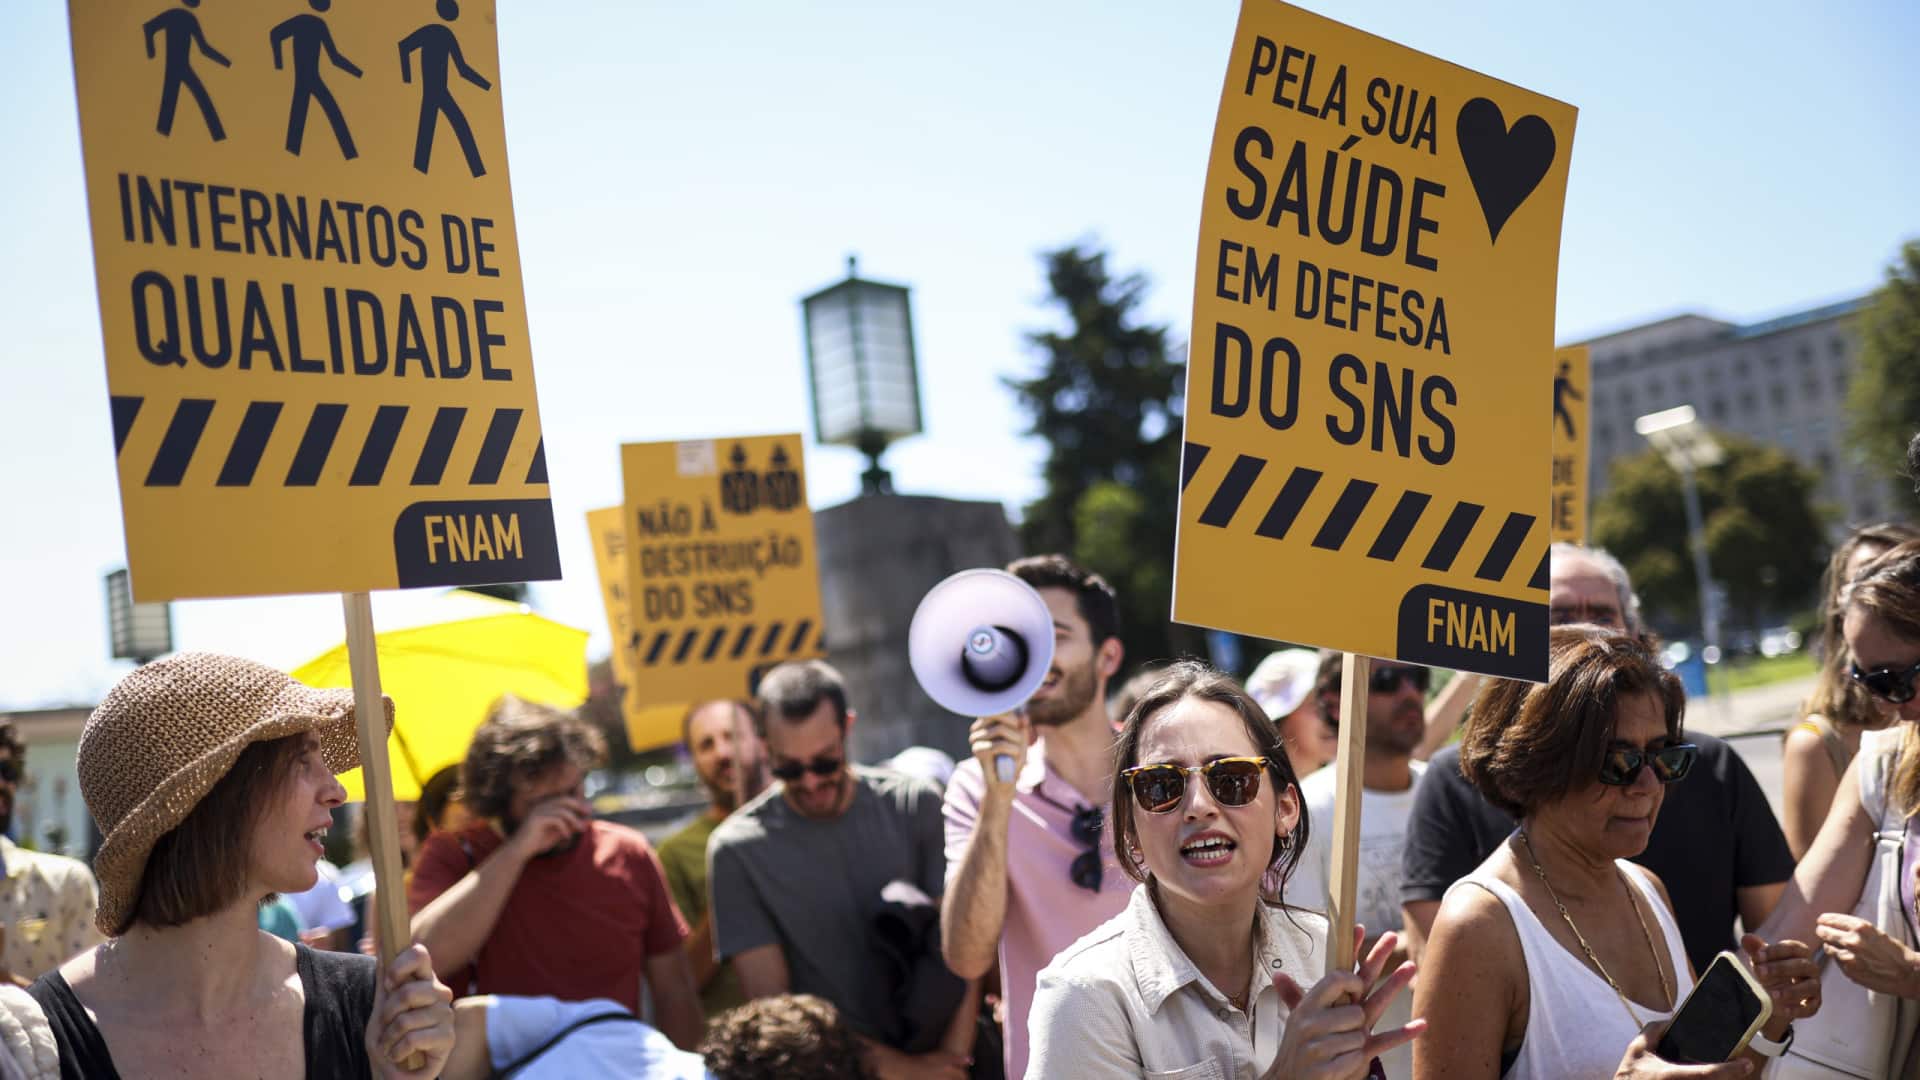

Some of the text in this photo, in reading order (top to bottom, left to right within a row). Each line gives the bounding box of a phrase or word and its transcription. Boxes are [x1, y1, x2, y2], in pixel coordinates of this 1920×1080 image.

[1245, 35, 1437, 155] PELA SUA
[117, 172, 500, 277] INTERNATOS DE
[1226, 126, 1447, 272] SAÚDE
[130, 270, 513, 382] QUALIDADE
[1216, 239, 1451, 355] EM DEFESA
[1211, 322, 1458, 466] DO SNS
[425, 513, 523, 563] FNAM
[638, 498, 690, 537] NÃO
[641, 530, 803, 578] DESTRUIÇÃO
[644, 585, 684, 621] DO
[693, 579, 754, 618] SNS
[1427, 598, 1516, 656] FNAM
